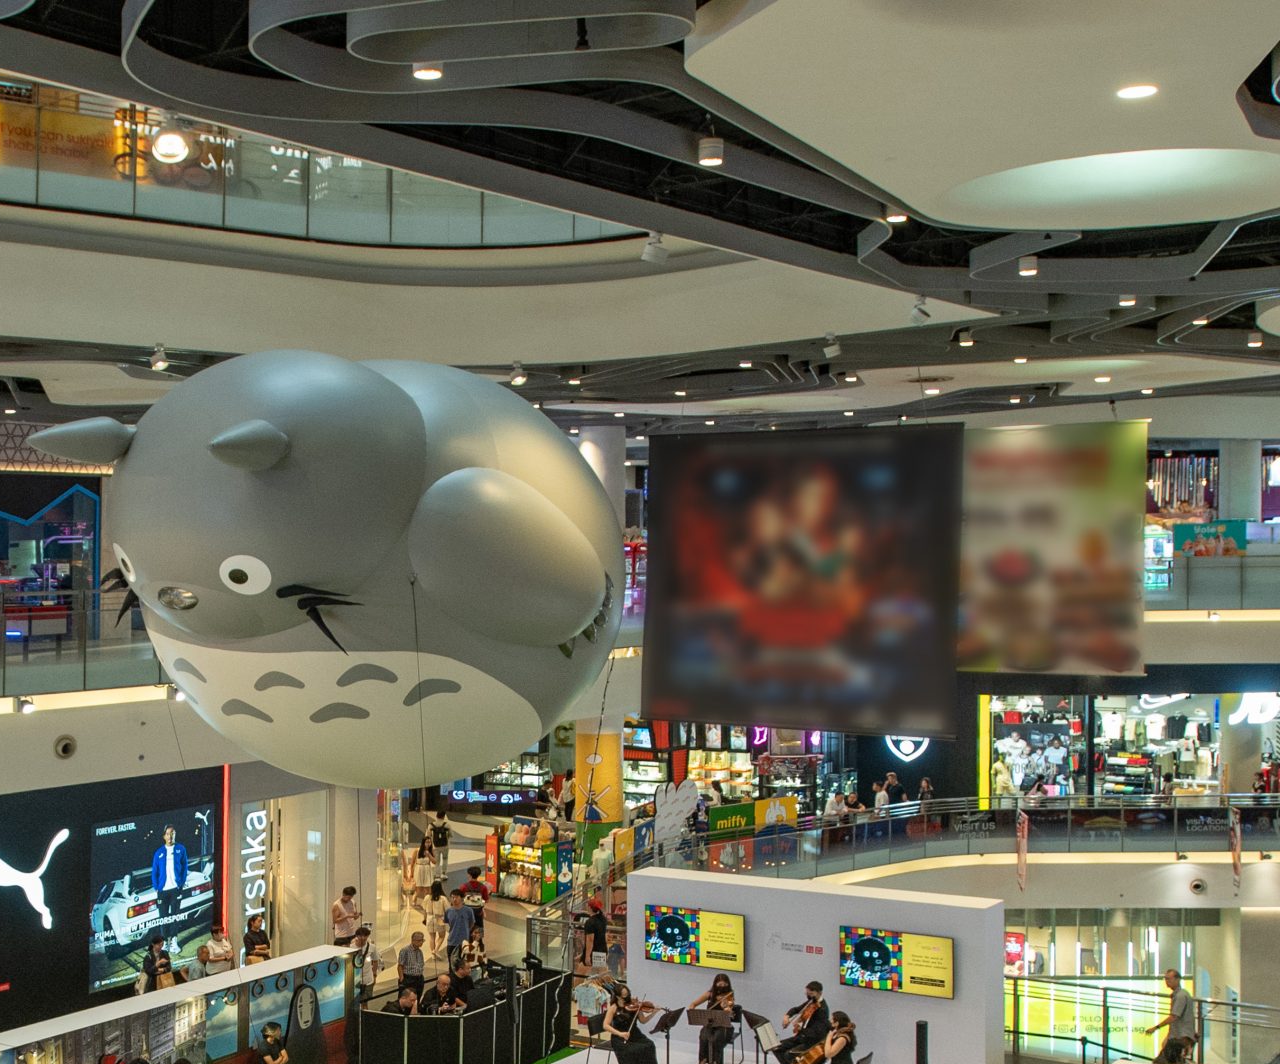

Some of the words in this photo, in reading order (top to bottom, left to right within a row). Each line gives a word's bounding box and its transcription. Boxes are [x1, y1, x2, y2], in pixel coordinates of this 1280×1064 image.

[96, 823, 117, 836] FOREVER.
[117, 822, 136, 833] FASTER.
[717, 815, 747, 830] miffy
[982, 822, 996, 830] US
[94, 930, 114, 941] PUMA
[146, 913, 188, 929] MOTORSPORT
[1113, 1015, 1125, 1023] US
